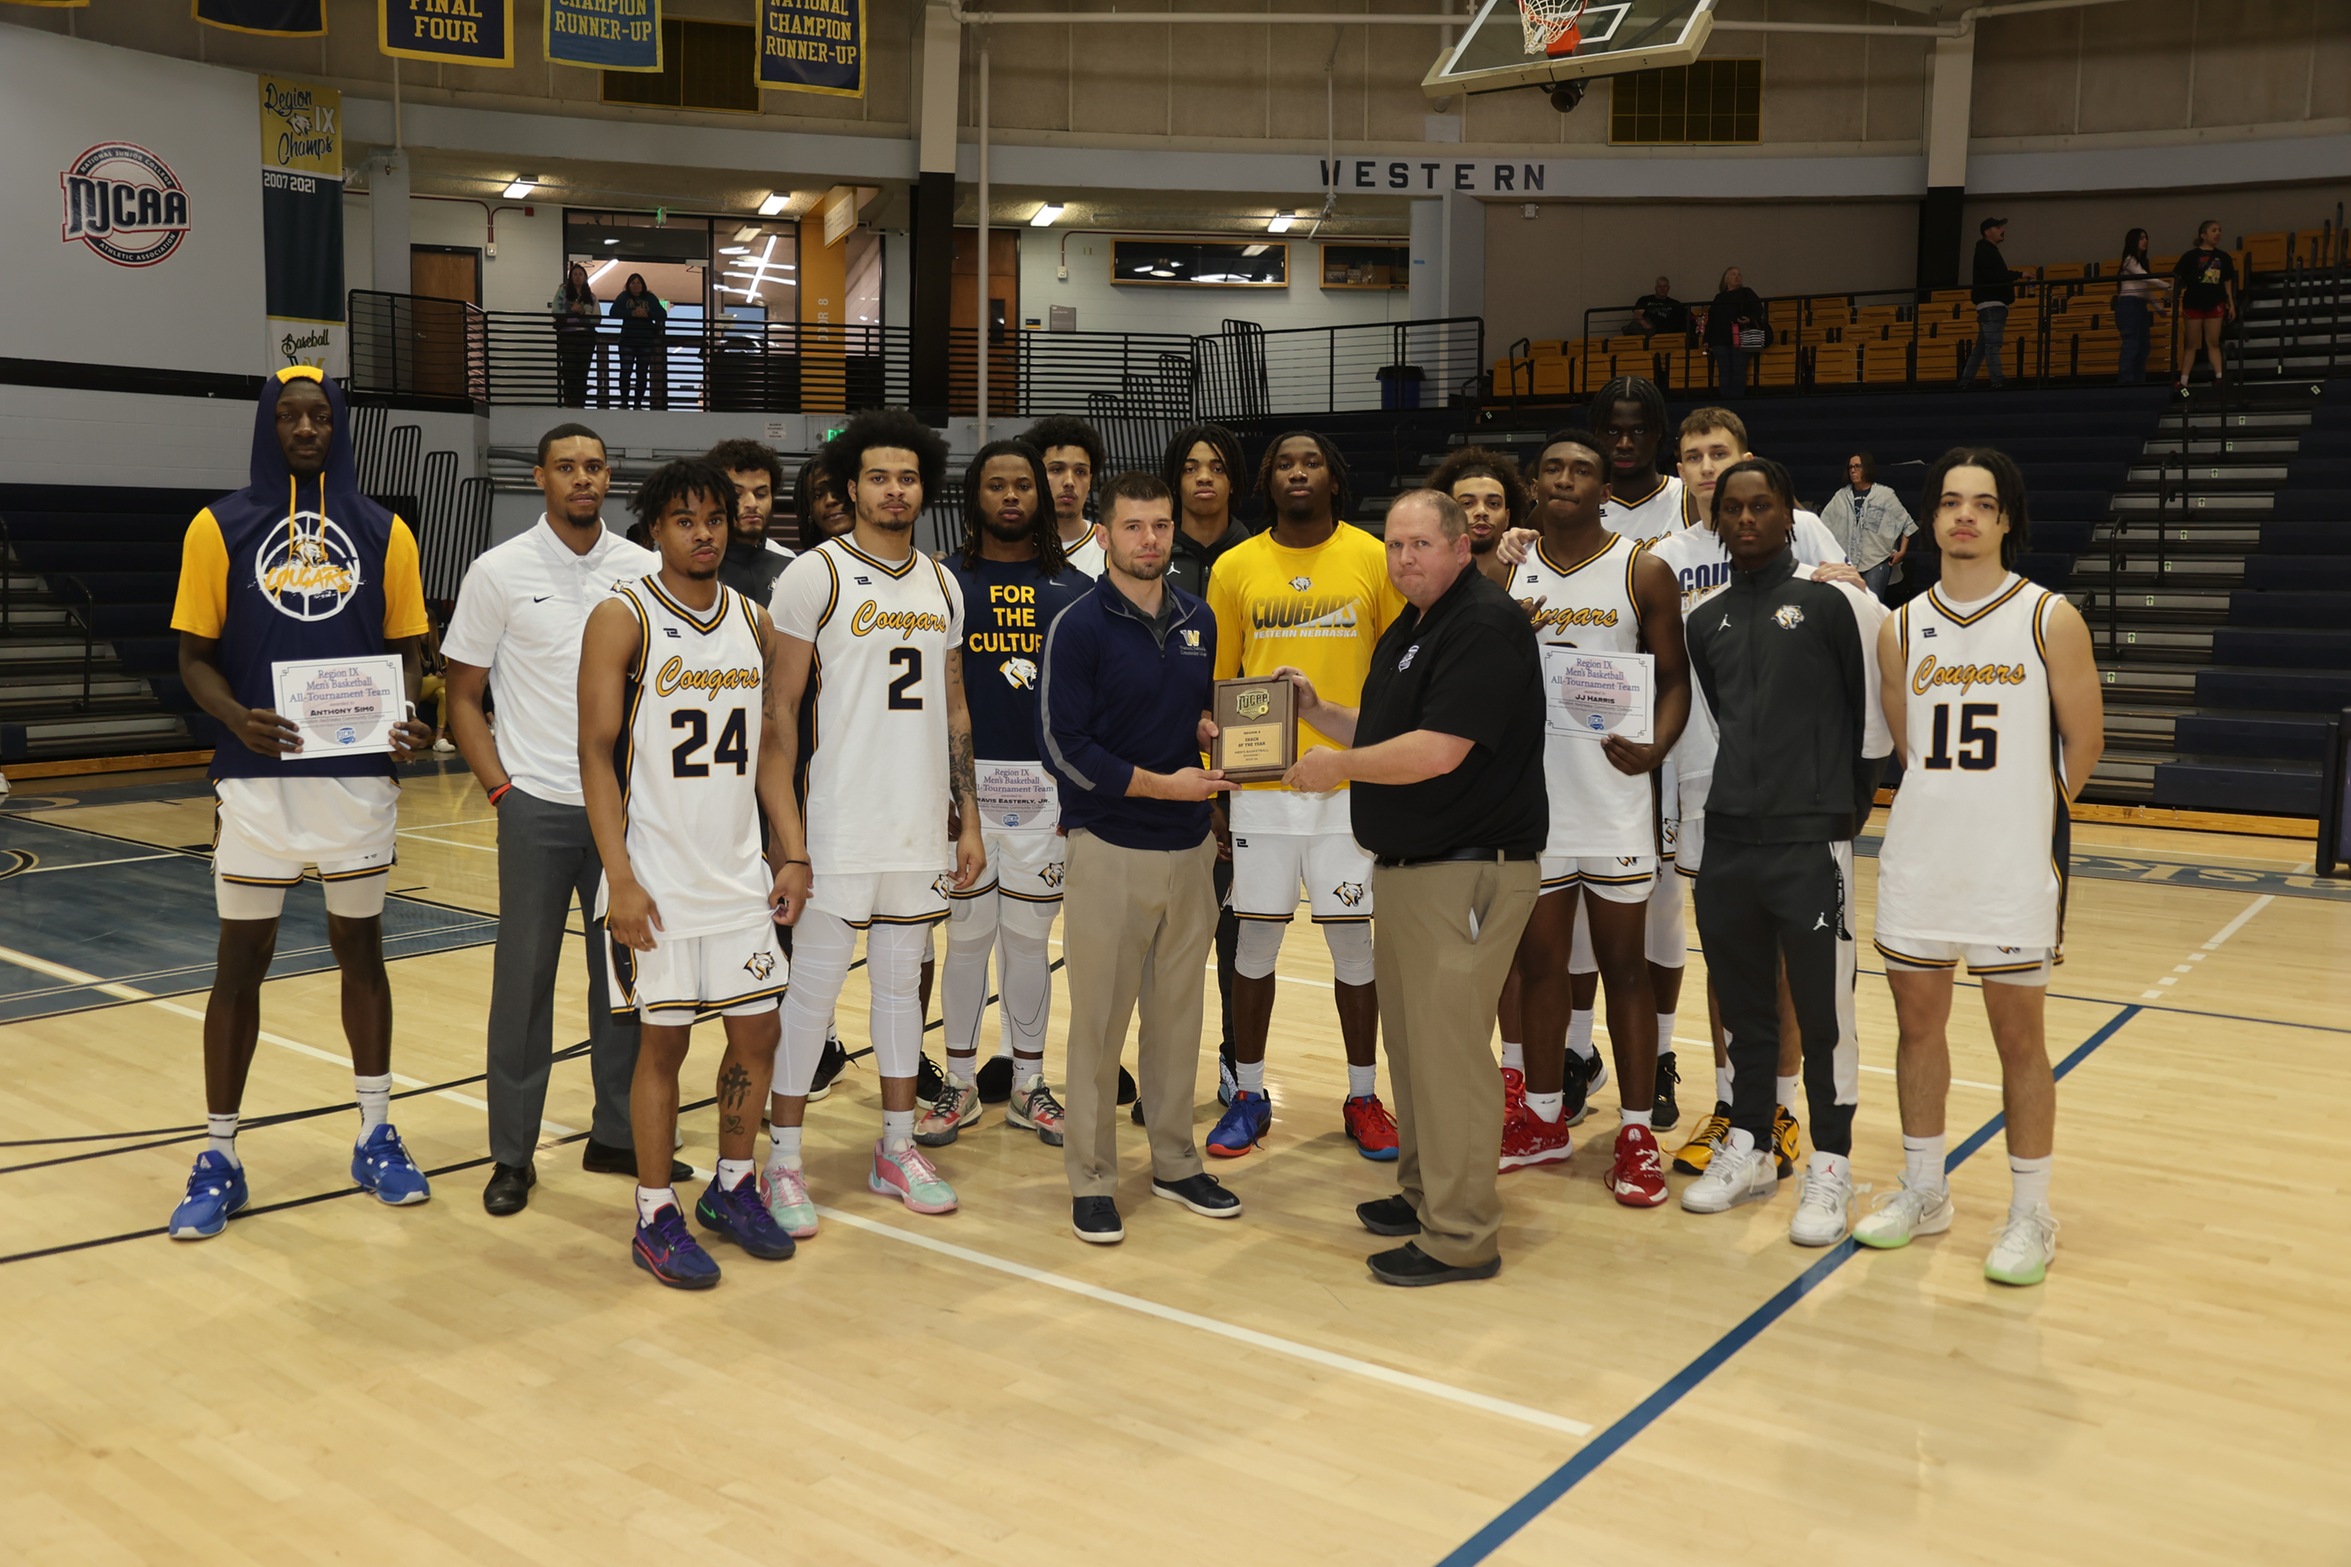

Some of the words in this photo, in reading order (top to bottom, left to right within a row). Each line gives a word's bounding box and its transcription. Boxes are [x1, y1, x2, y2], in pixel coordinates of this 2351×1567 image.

[560, 0, 647, 16] MPION
[414, 15, 478, 43] FOUR
[554, 10, 652, 41] RUNNER-UP
[769, 11, 852, 41] CHAMPION
[765, 35, 857, 65] RUNNER-UP
[264, 82, 312, 117] Region
[315, 105, 336, 135] IX
[278, 131, 334, 165] Champs
[80, 151, 113, 173] NATIONAL
[115, 150, 144, 161] JUNIOR
[144, 159, 172, 186] COLLEGE
[1320, 159, 1545, 191] WESTERN
[264, 172, 289, 189] 2007
[290, 176, 316, 194] 2021
[67, 176, 187, 235] NJCAA
[99, 242, 134, 261] ATHLETIC
[136, 233, 176, 260] ASSOCIATION
[817, 298, 829, 306] 8
[281, 328, 331, 356] Baseball
[264, 566, 352, 593] COUGARS
[990, 585, 1035, 604] FOR
[851, 600, 946, 640] Cougars
[993, 607, 1036, 627] THE
[1252, 594, 1361, 630] COUGARS
[1520, 597, 1618, 635] ugars
[1254, 629, 1297, 639] WESTERN
[1300, 629, 1357, 638] NEBRASKA
[318, 669, 347, 680] Region
[348, 667, 360, 677] IX
[655, 655, 760, 701] Cougars
[1565, 667, 1586, 677] Men's
[1587, 668, 1624, 681] Basketball
[1576, 658, 1602, 670] Region
[1603, 660, 1613, 670] IX
[1912, 654, 2026, 696] Cougars
[306, 680, 330, 691] Men's
[331, 677, 373, 688] Basketball
[888, 647, 923, 710] 2
[1550, 675, 1615, 690] All-Tournament
[1616, 681, 1640, 692] Team
[289, 690, 363, 703] All-Tournament
[365, 688, 391, 697] Team
[1587, 695, 1616, 704] HARRIS
[310, 708, 352, 716] ANTHONY
[354, 706, 374, 714] SIMO
[670, 707, 749, 778] 24
[1924, 703, 1999, 771] 15
[983, 776, 1003, 784] Men's
[1004, 776, 1040, 785] Basketball
[994, 768, 1020, 777] Region
